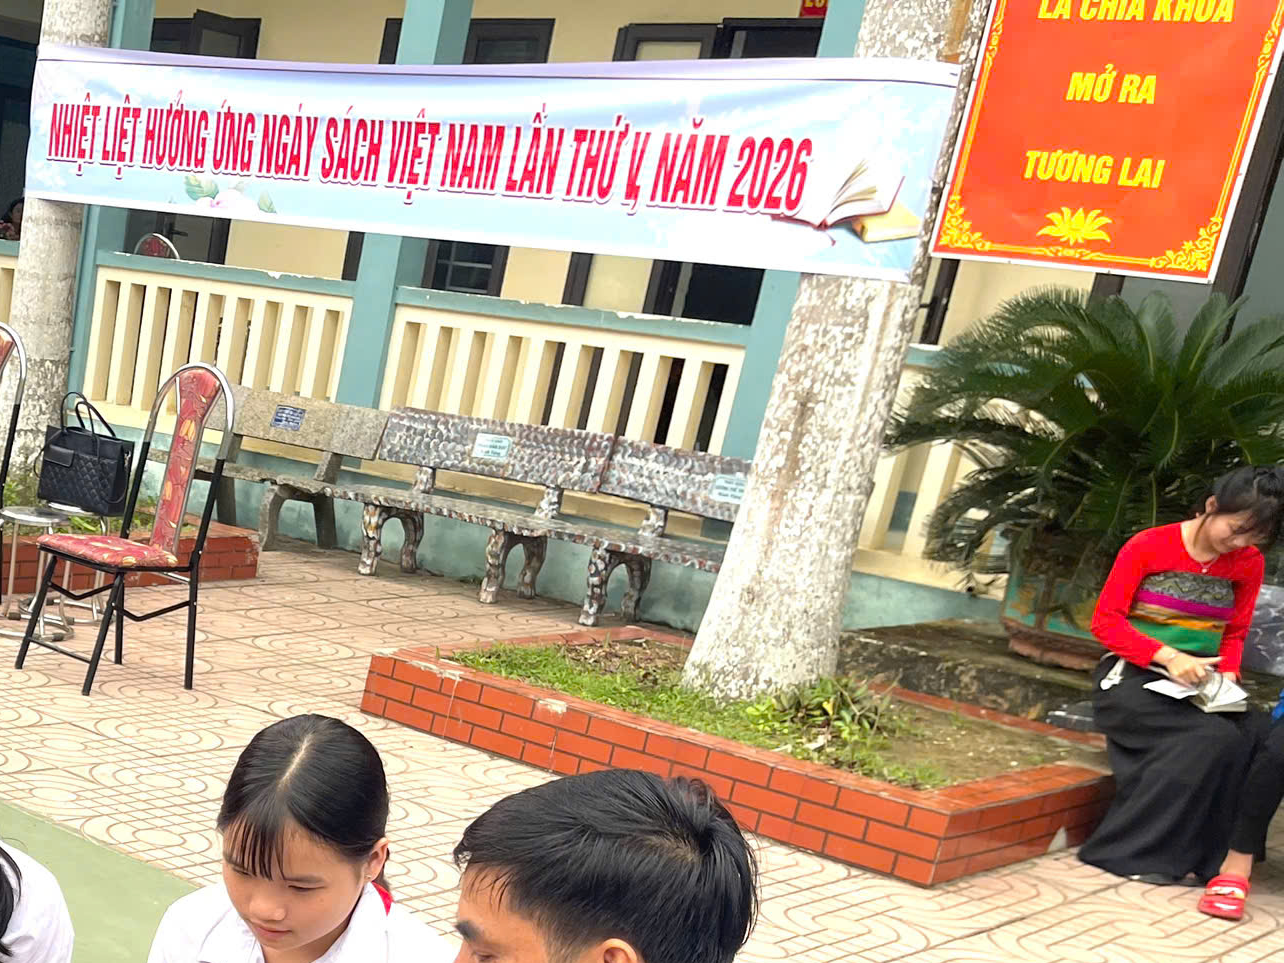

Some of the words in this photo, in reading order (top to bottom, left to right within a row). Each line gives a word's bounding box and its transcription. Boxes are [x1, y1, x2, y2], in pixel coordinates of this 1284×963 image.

[1066, 64, 1117, 103] MỞ
[1118, 73, 1157, 105] RA
[48, 92, 101, 172] NHIỆT
[101, 94, 141, 175] LIỆT
[142, 90, 209, 169] HƯỞNG
[213, 99, 256, 173] ỨNG
[258, 103, 319, 177] NGÀY
[321, 105, 384, 182] SÁCH
[387, 108, 441, 200] VIỆT
[440, 123, 506, 191] NAM
[505, 103, 565, 195] LẦN
[566, 115, 630, 200] THỨ
[649, 118, 730, 206] NĂM
[727, 136, 813, 211] 2026
[1024, 149, 1114, 184] TƯƠNG
[1117, 157, 1166, 188] LAI
